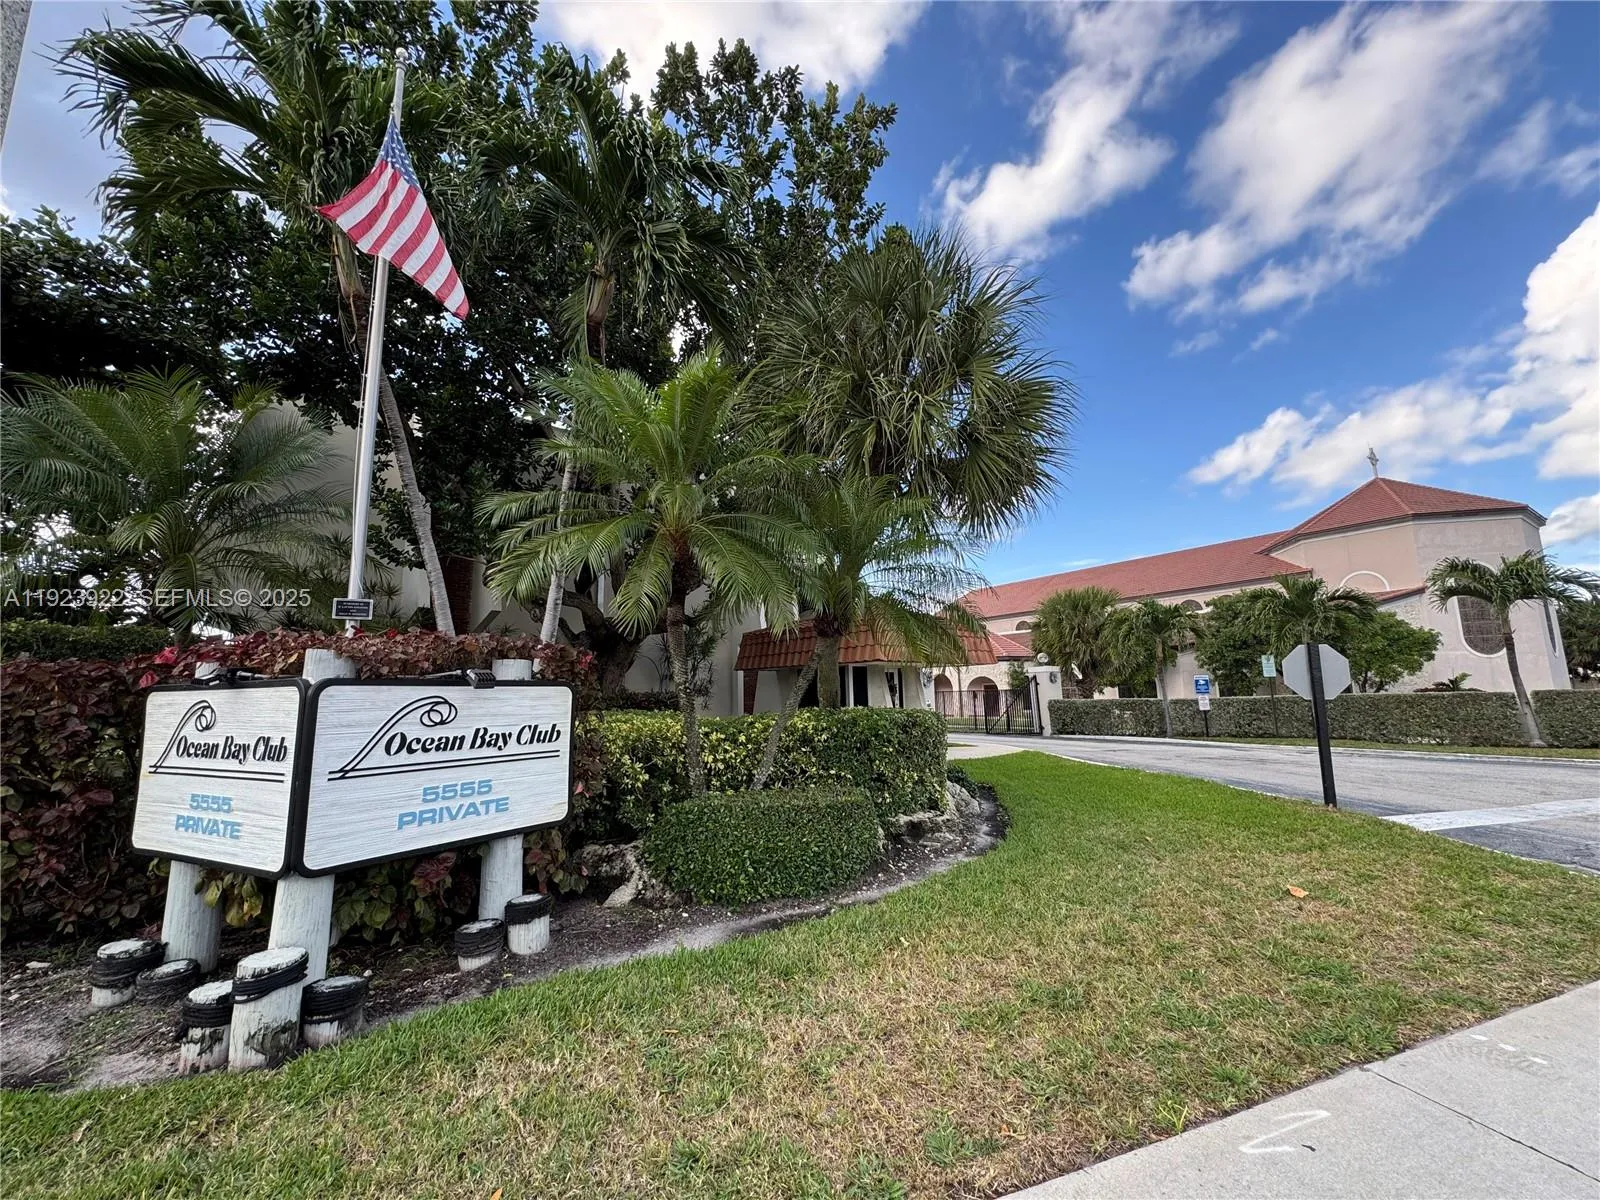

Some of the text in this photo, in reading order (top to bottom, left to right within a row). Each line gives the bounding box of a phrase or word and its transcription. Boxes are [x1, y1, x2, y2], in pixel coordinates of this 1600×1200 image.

[176, 735, 288, 765] Ocean Bay Club
[384, 724, 561, 756] Ocean Bay Club
[189, 793, 233, 813] 5555
[421, 779, 493, 803] 5555
[175, 815, 241, 839] PRIVATE
[397, 797, 510, 831] PRIVATE
